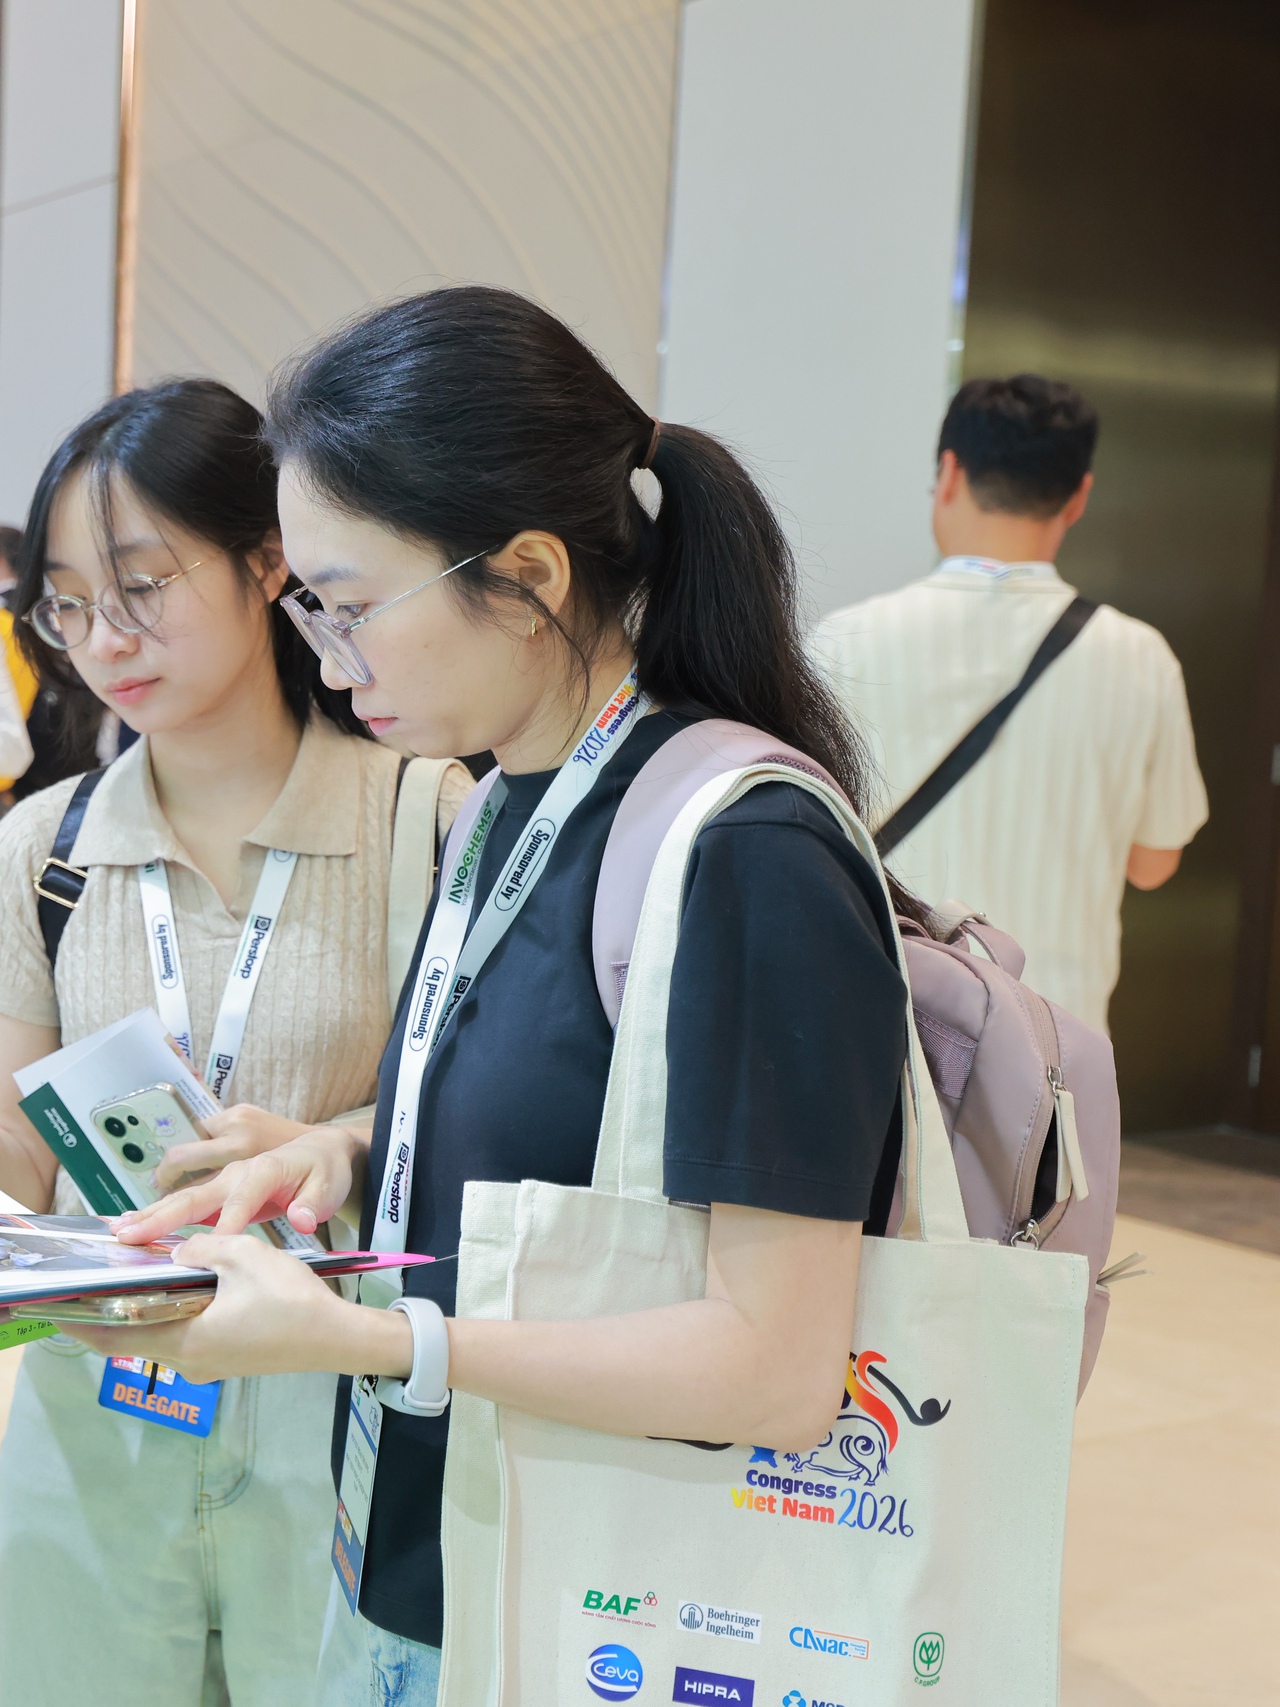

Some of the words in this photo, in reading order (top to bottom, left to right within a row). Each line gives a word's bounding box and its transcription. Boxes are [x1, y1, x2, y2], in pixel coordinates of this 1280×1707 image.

[613, 684, 635, 705] Viet
[595, 703, 620, 729] Nam
[607, 696, 638, 736] Congress
[572, 726, 610, 767] 2026
[510, 829, 551, 887] Sponsored
[460, 892, 468, 906] Your
[464, 859, 478, 893] Expectation
[500, 886, 520, 900] by
[155, 924, 168, 935] by
[156, 935, 173, 981] Sponsored
[240, 931, 266, 980] Perstorp
[412, 982, 438, 1040] Sponsored
[427, 968, 444, 981] by
[212, 1070, 228, 1101] Pers
[387, 1163, 405, 1224] Perstorp
[28, 1324, 33, 1332] 3
[113, 1382, 201, 1425] DELEGATE
[746, 1469, 837, 1499] Congress
[731, 1487, 777, 1513] Viet
[782, 1497, 835, 1524] Nam
[838, 1488, 914, 1538] 2026
[582, 1589, 642, 1616] BAF
[707, 1608, 760, 1627] Boehringer
[706, 1621, 754, 1640] Ingelheim
[684, 1680, 741, 1701] HIPRA
